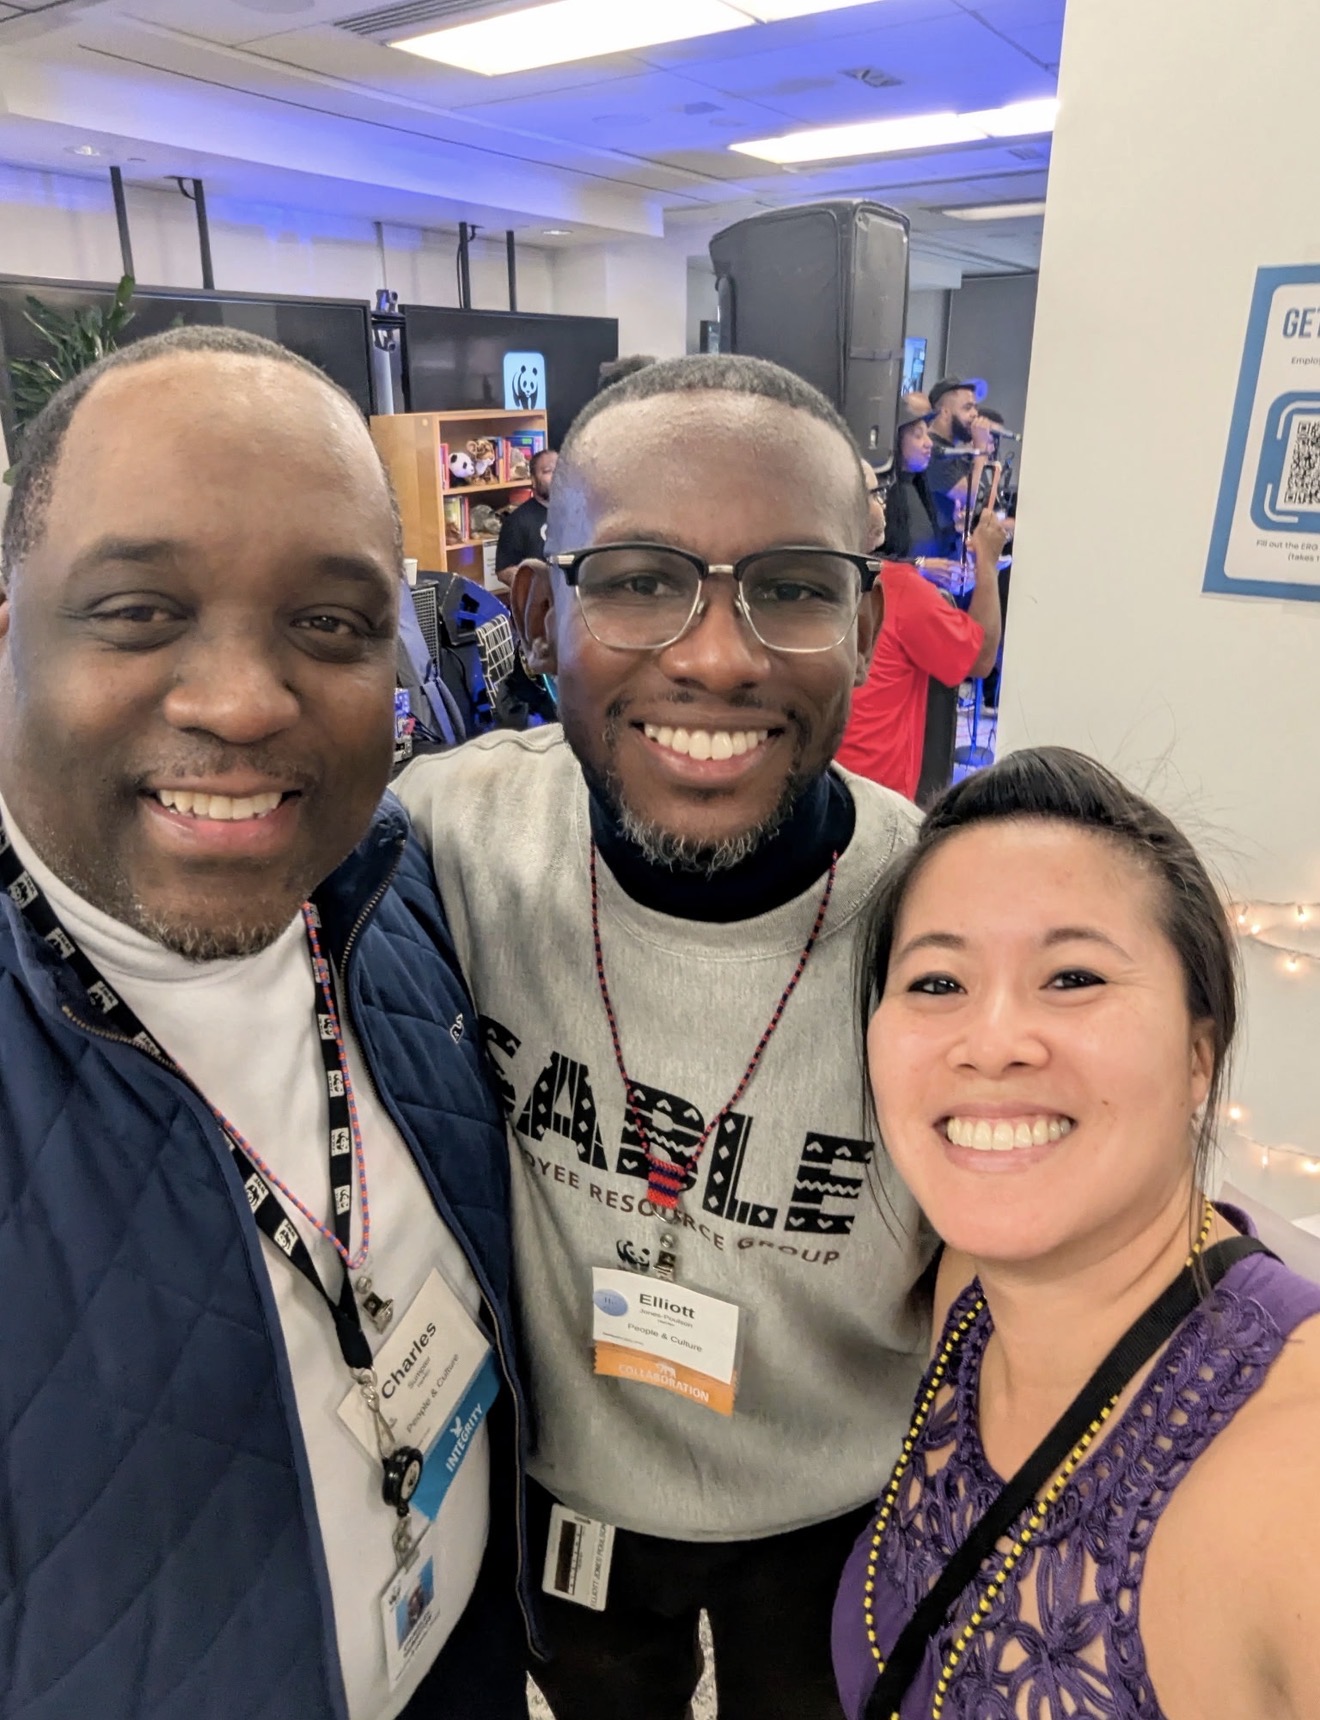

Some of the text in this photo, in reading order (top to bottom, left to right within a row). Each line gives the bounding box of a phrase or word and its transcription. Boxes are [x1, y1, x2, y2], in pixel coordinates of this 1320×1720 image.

[1282, 306, 1320, 339] GE
[1291, 356, 1320, 367] Emplo
[1285, 541, 1299, 550] the
[639, 1293, 695, 1319] Elliott
[627, 1323, 659, 1339] People
[661, 1332, 668, 1340] &
[670, 1335, 703, 1353] Culture
[381, 1322, 437, 1400] Charles
[406, 1397, 431, 1434] People
[431, 1388, 438, 1399] &
[436, 1352, 460, 1388] Culture
[618, 1363, 710, 1402] COLLABORATION
[445, 1402, 483, 1473] INTEGRITY
